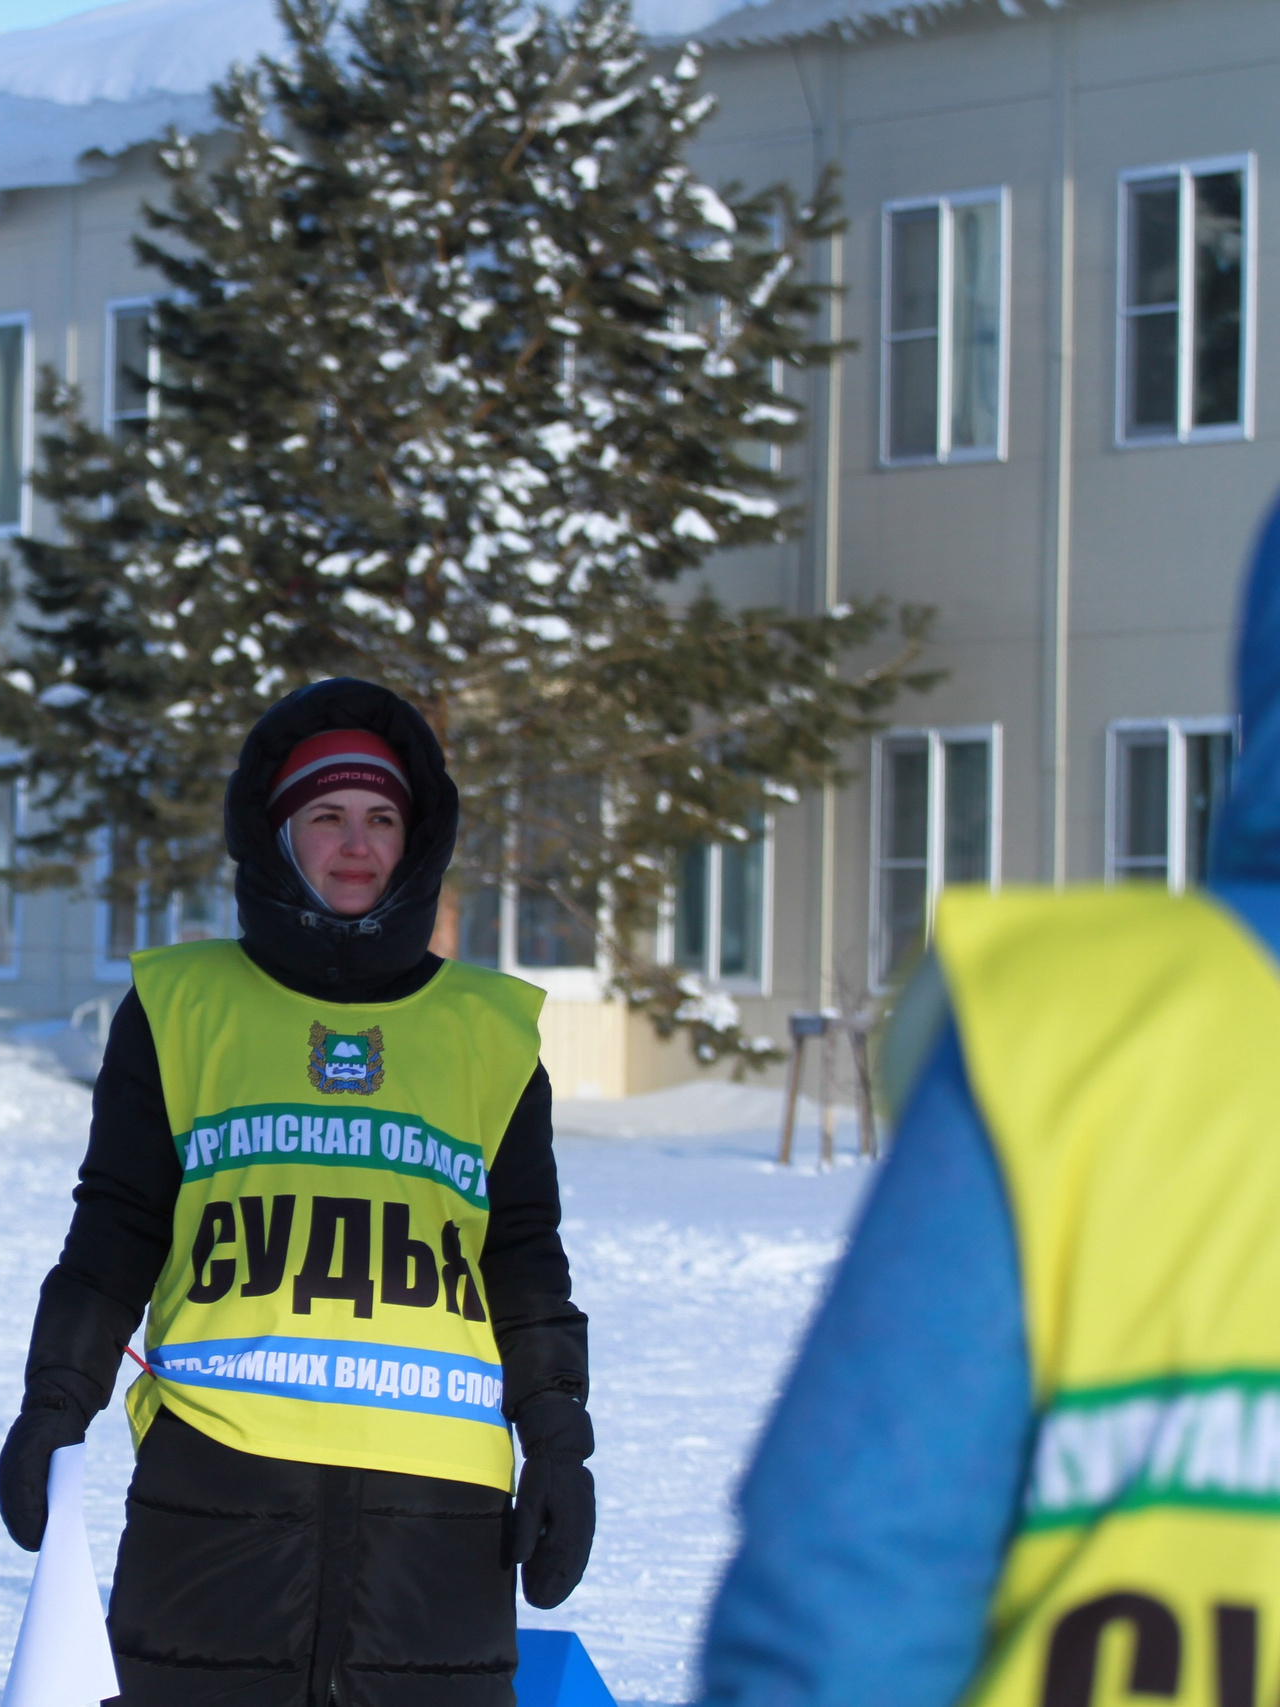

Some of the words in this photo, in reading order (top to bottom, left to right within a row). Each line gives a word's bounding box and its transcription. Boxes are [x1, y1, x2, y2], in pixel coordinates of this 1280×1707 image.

[317, 772, 385, 785] NORDSKI
[186, 1195, 487, 1322] СУДЬЯ
[334, 1356, 440, 1399] ВИДОВ
